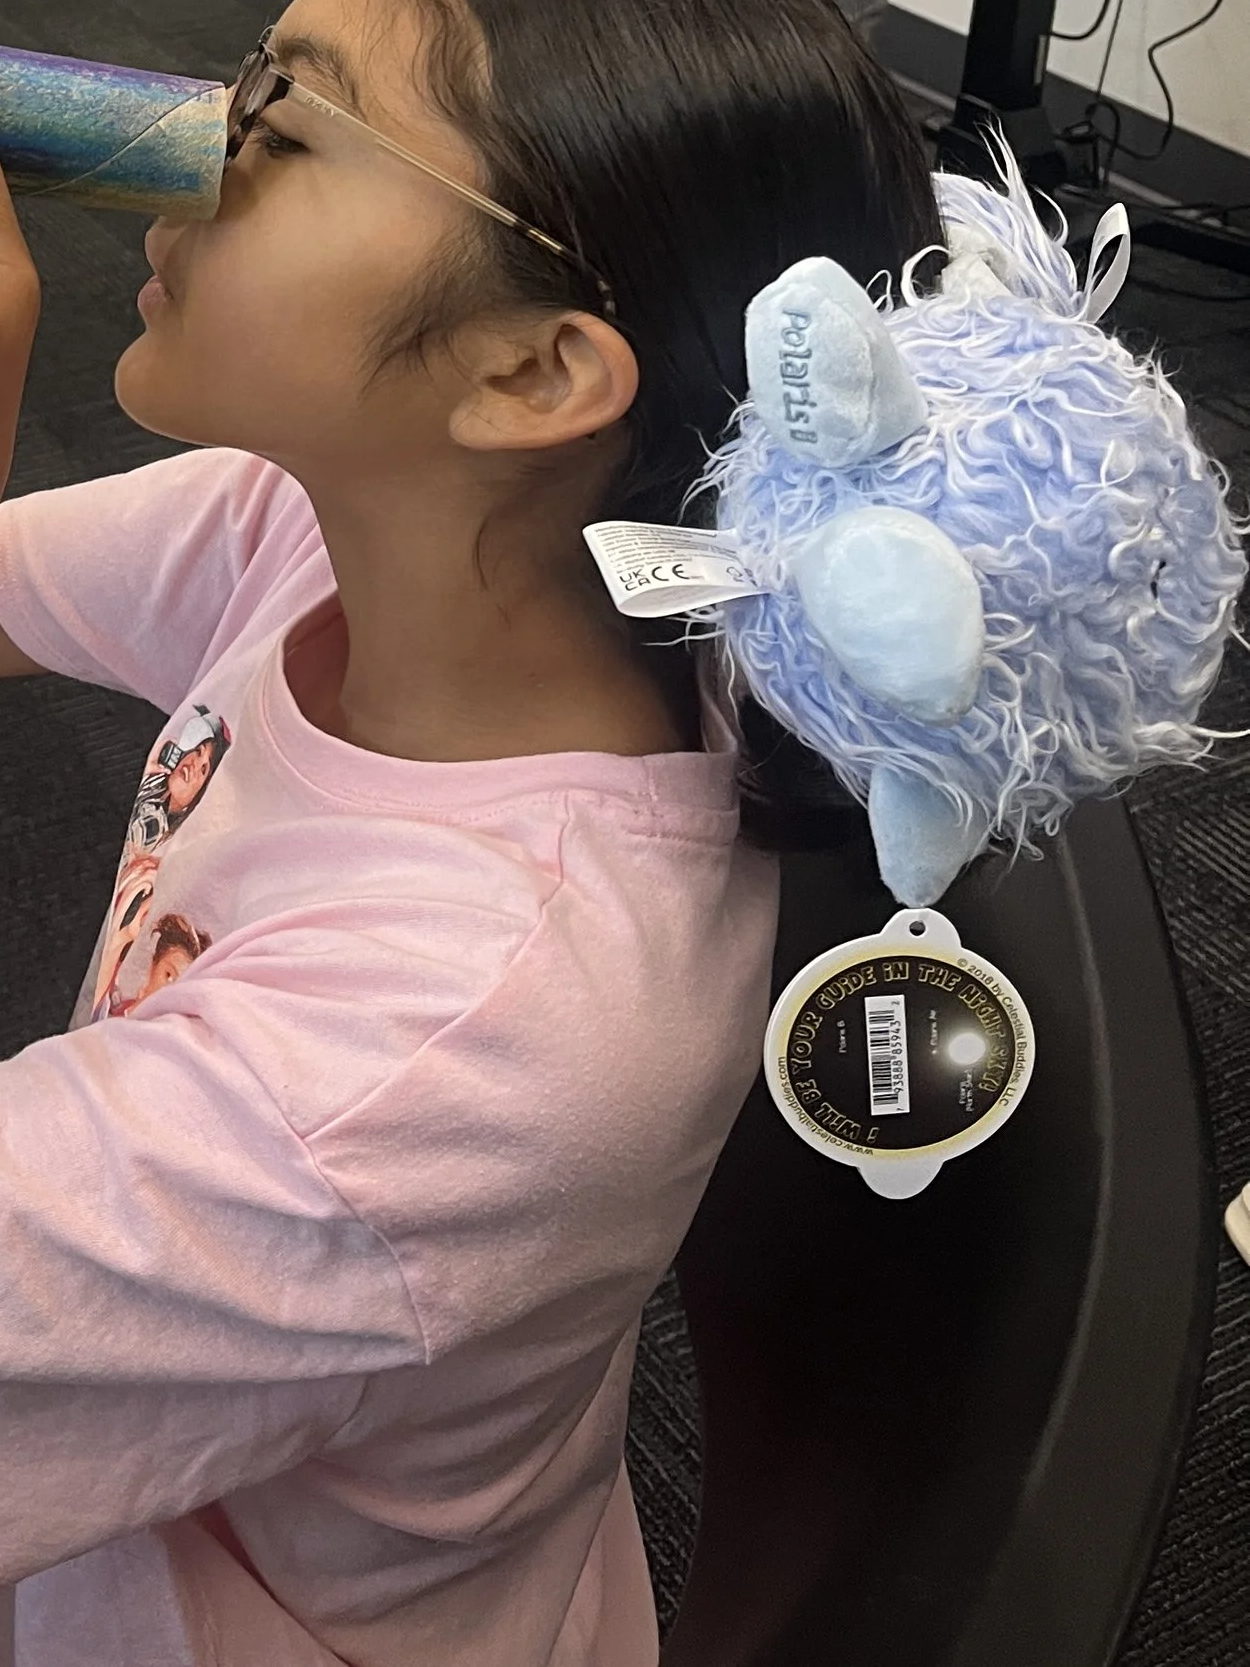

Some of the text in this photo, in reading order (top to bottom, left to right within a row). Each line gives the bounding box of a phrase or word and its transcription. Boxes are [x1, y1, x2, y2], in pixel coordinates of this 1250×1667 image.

[790, 1011, 823, 1075] YOUR
[917, 963, 963, 992] THE
[890, 1020, 902, 1055] 85943
[893, 1060, 904, 1094] 93888
[998, 1086, 1017, 1107] LLC
